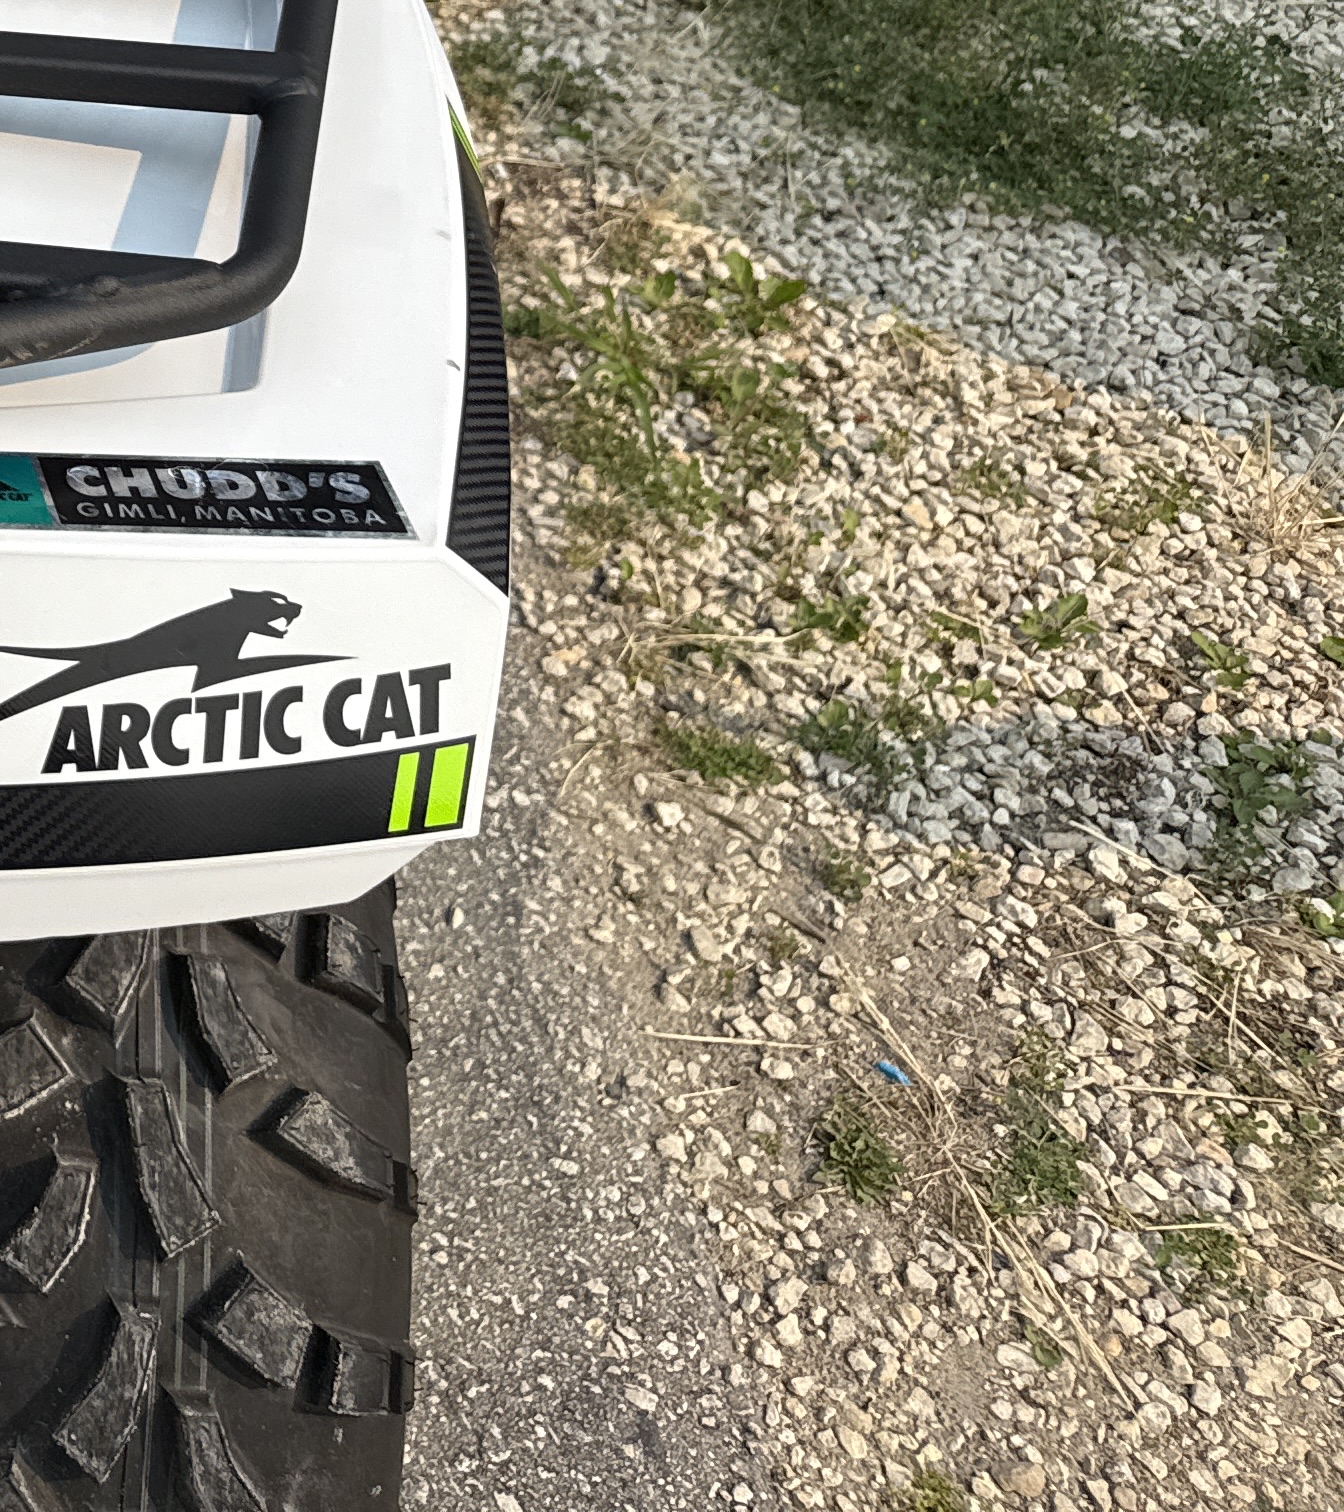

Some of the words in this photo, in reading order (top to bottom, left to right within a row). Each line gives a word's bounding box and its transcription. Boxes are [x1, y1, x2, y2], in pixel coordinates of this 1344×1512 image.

[7, 492, 33, 502] CAT
[65, 464, 371, 504] CHUDD'S
[194, 504, 388, 527] MANITOBA
[40, 684, 304, 775] ARCTIC
[322, 662, 452, 748] CAT
